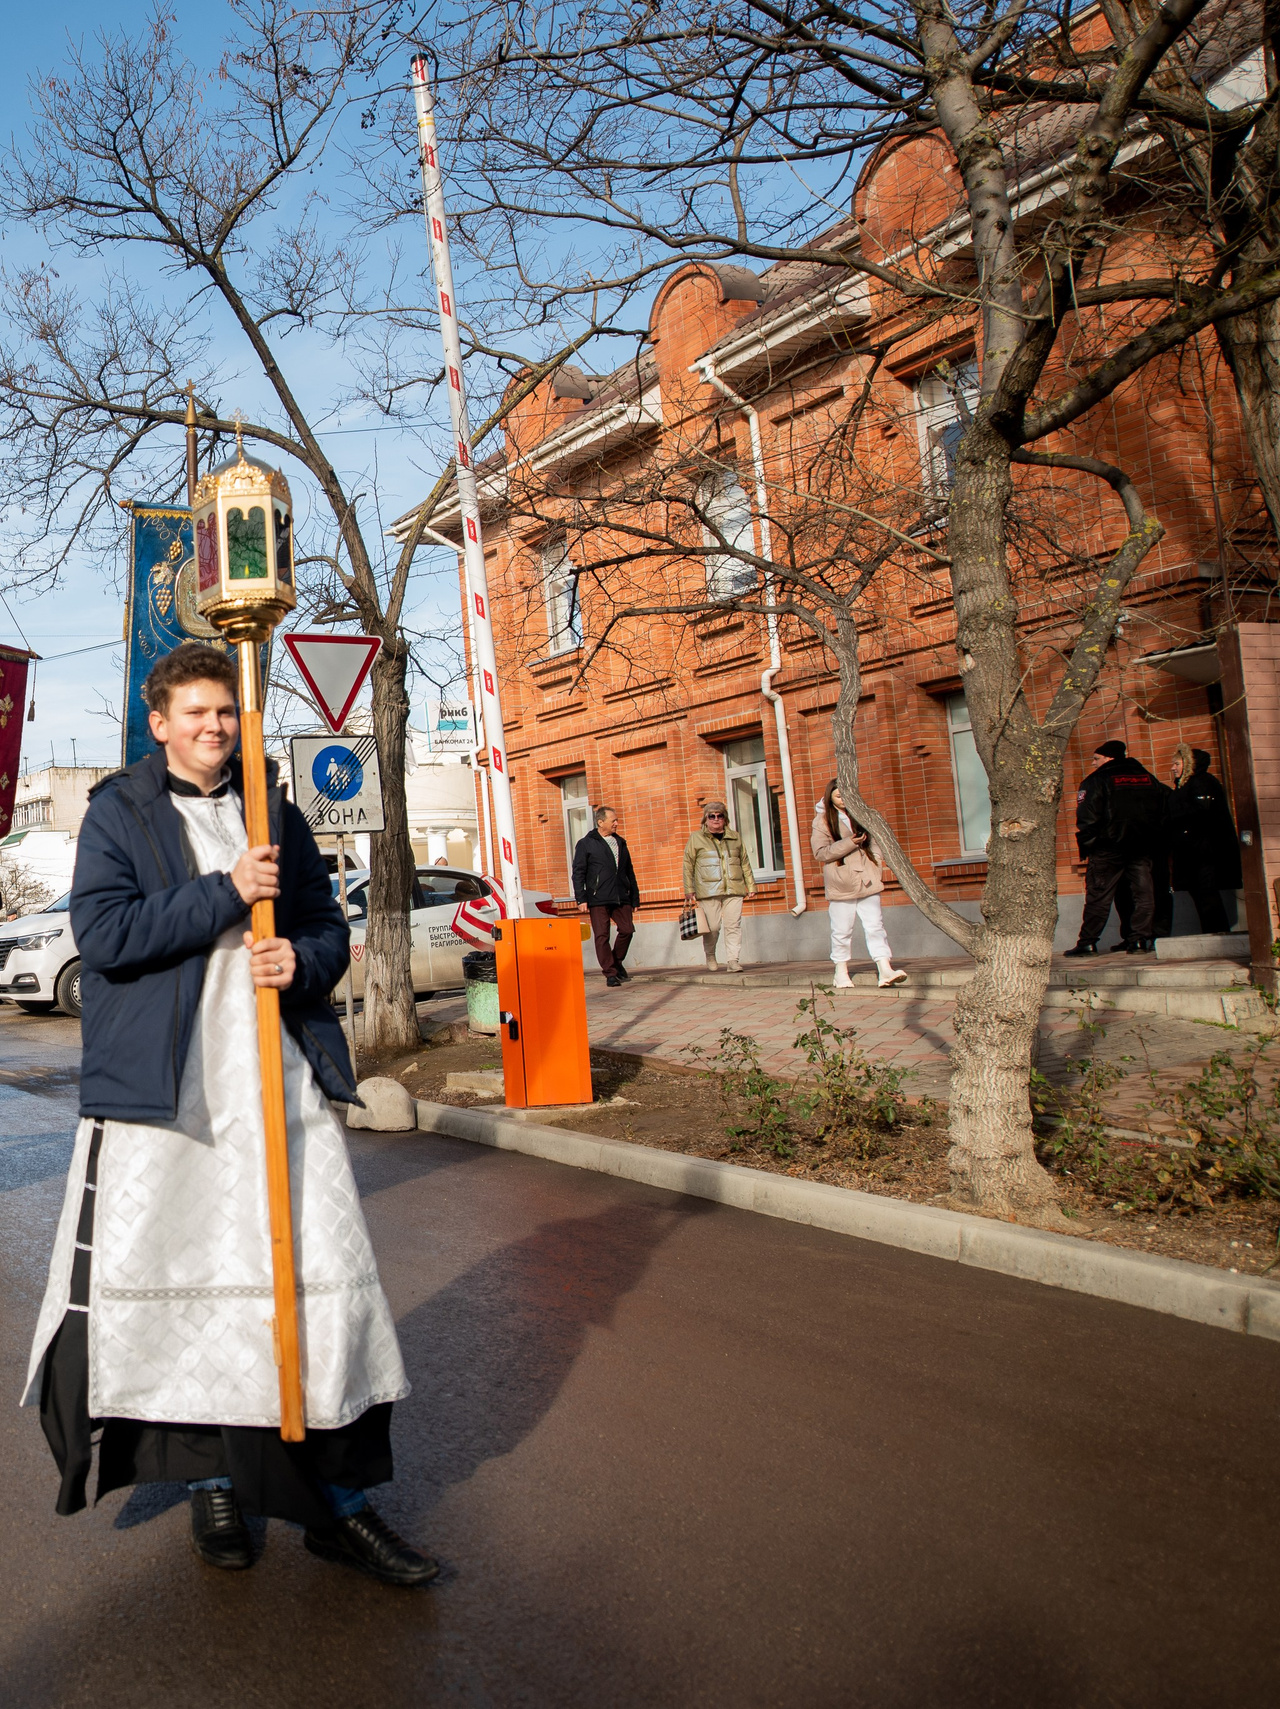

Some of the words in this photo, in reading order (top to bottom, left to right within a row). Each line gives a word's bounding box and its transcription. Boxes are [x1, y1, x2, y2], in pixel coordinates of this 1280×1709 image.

[314, 808, 369, 825] ЗОНА
[428, 925, 452, 933] ГРУППА
[430, 931, 463, 940] БЫСТРОГО
[431, 937, 480, 948] РЕАГИРОВАНИЯ
